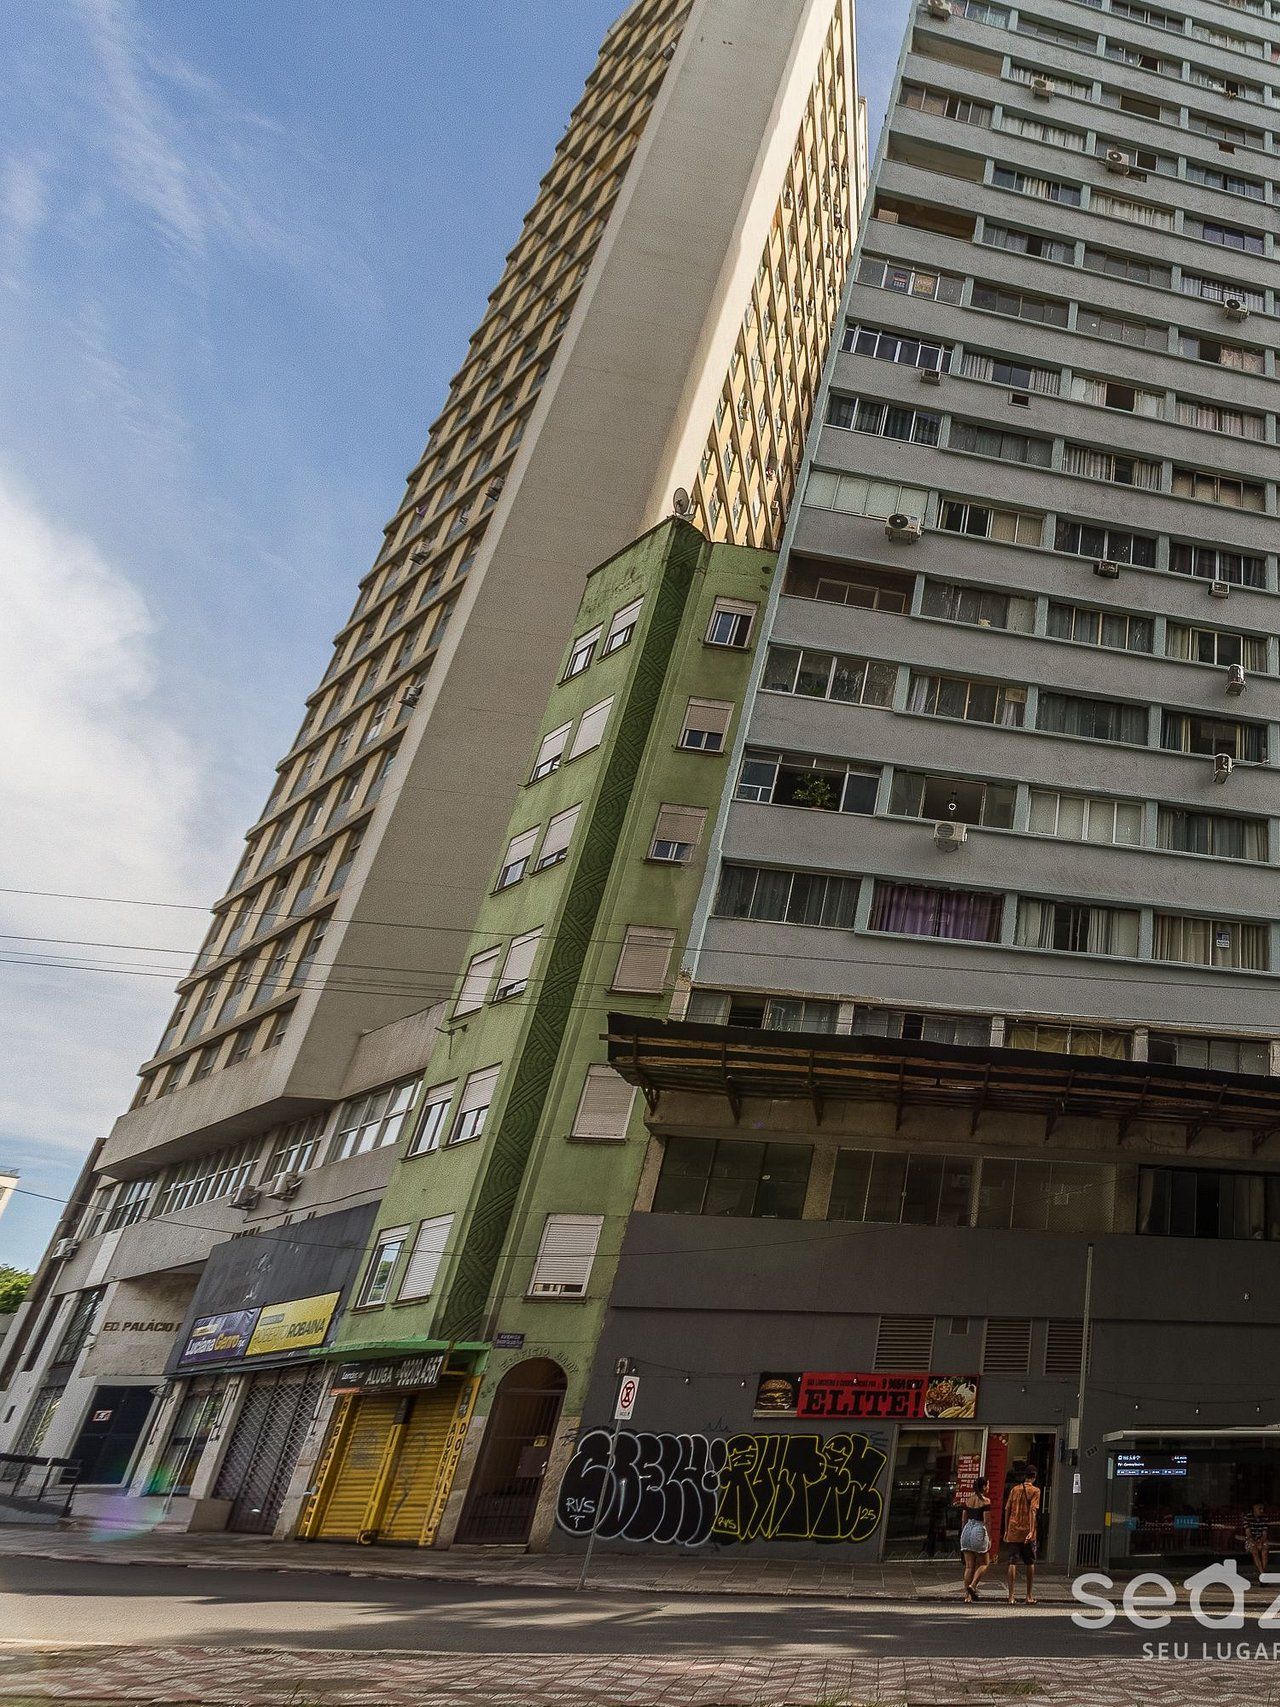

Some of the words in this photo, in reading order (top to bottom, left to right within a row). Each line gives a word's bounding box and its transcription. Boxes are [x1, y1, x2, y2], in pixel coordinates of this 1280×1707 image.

[122, 1319, 174, 1332] PALÁCIO
[286, 1318, 326, 1339] ROBAINA
[365, 1366, 394, 1386] ALUGA
[801, 1388, 922, 1418] ELITE!
